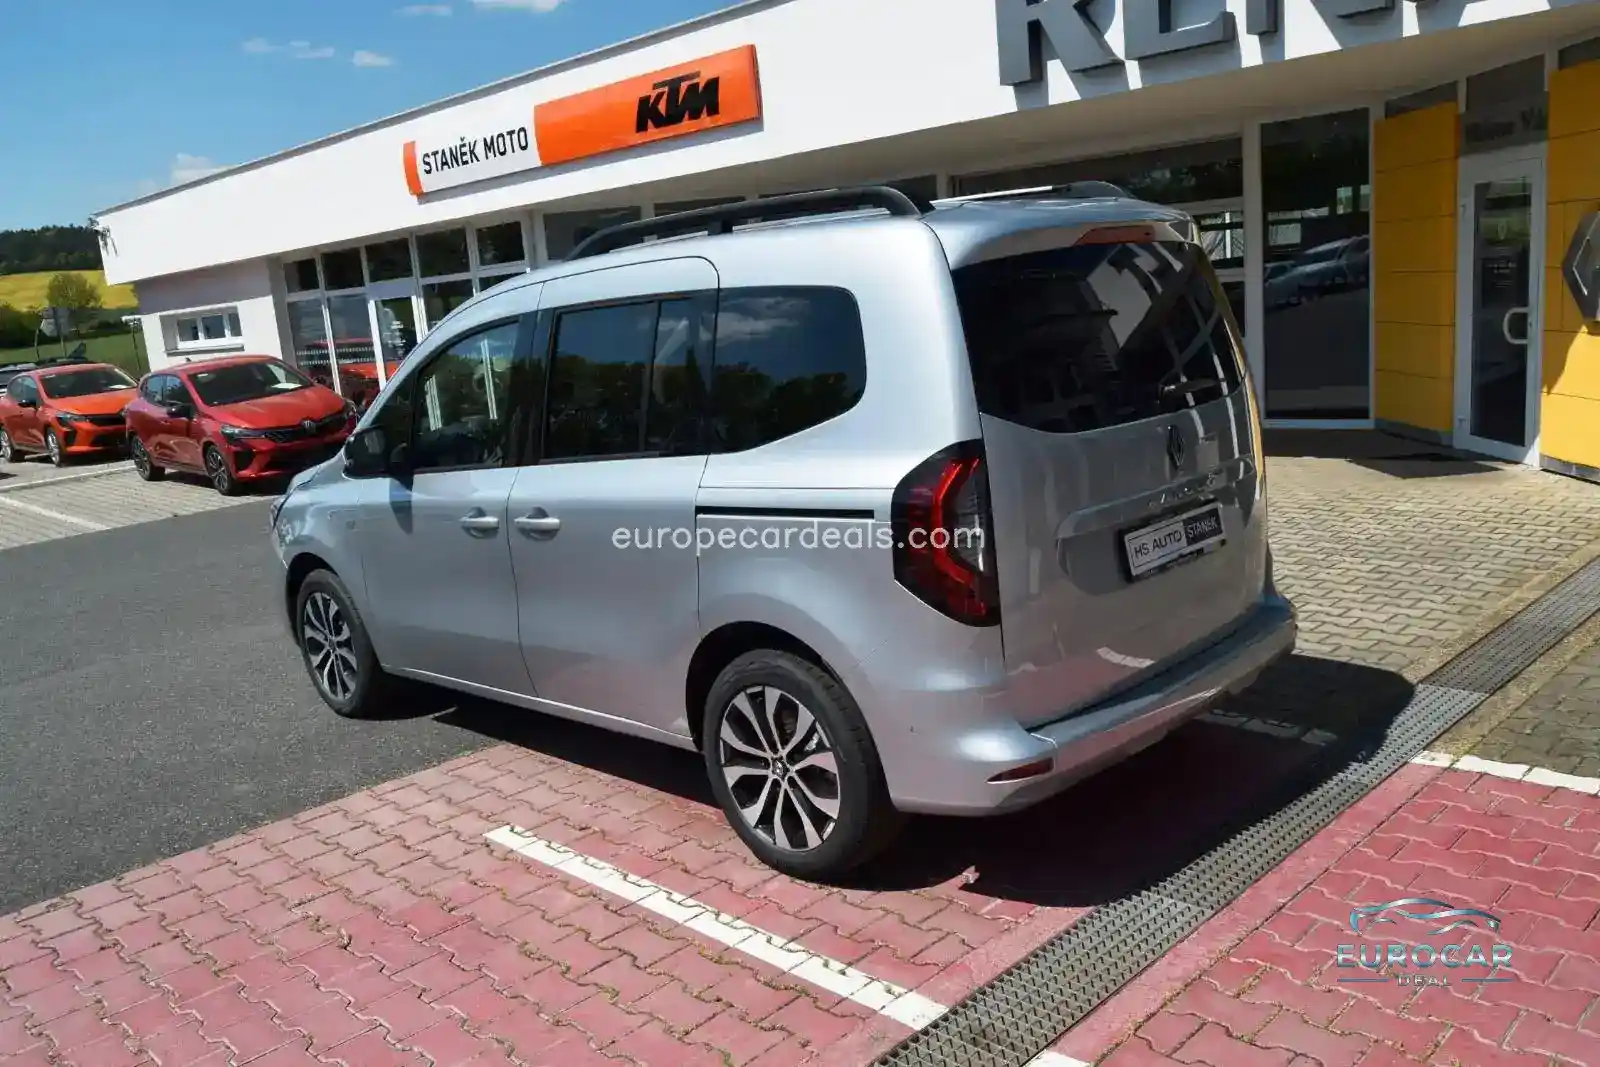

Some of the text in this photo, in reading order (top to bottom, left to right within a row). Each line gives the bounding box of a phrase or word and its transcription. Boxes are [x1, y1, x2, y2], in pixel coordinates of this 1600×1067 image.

[635, 71, 720, 133] KTM
[422, 126, 529, 175] STANĚK MOTO
[1134, 541, 1151, 560] HS
[1152, 529, 1183, 551] AUTO
